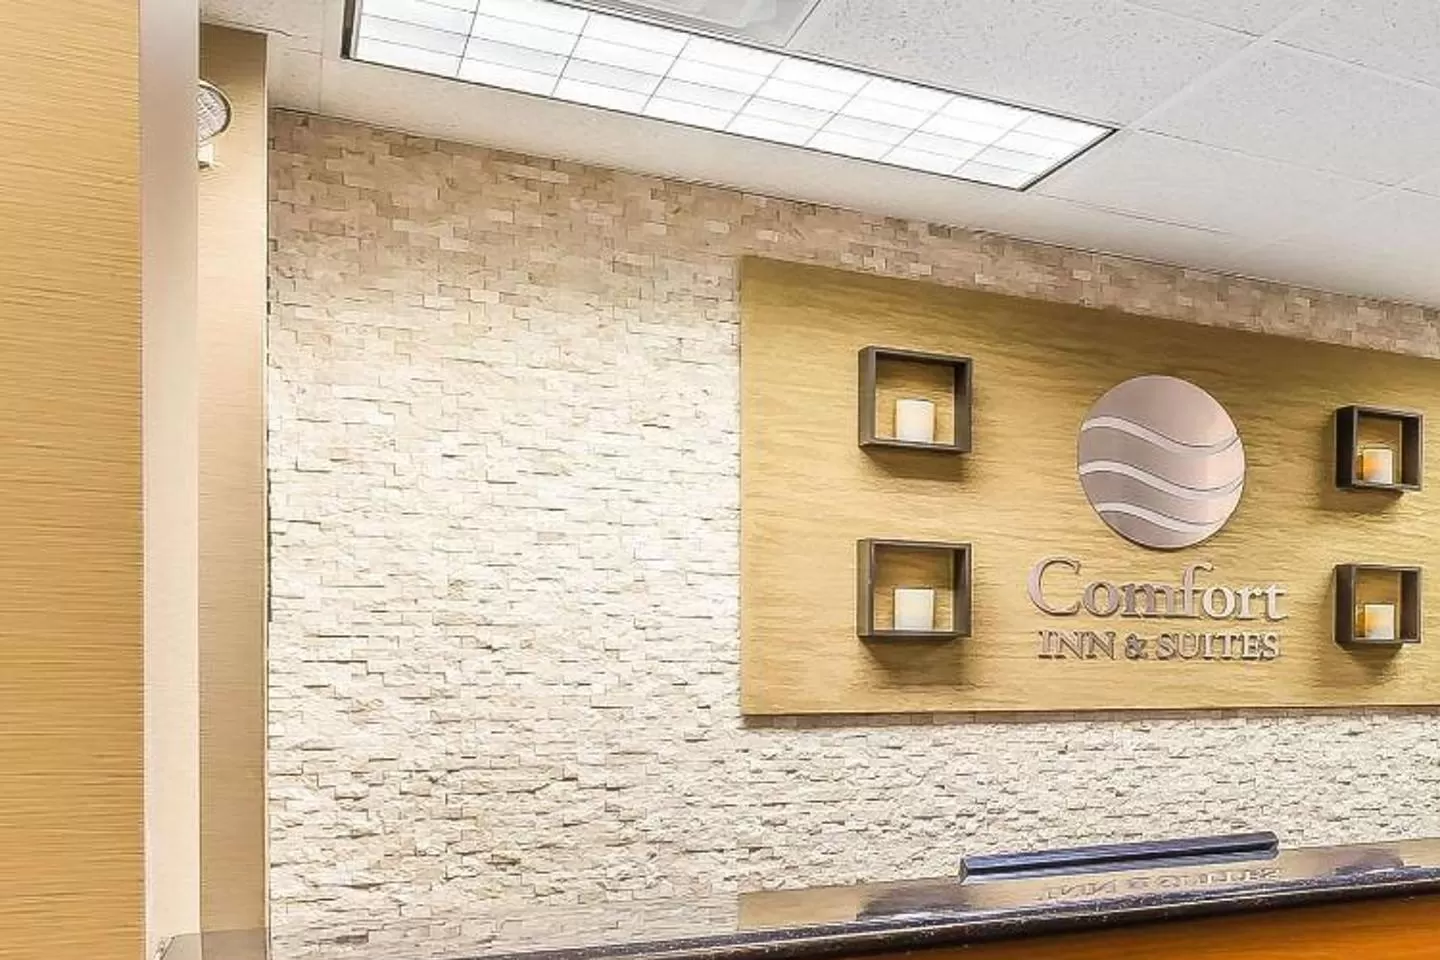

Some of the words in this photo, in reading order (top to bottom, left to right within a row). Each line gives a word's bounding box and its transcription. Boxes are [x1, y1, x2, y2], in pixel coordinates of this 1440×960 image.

[1027, 557, 1288, 620] Comfort
[1037, 629, 1117, 660] INN
[1124, 633, 1148, 660] &
[1157, 630, 1280, 660] SUITES
